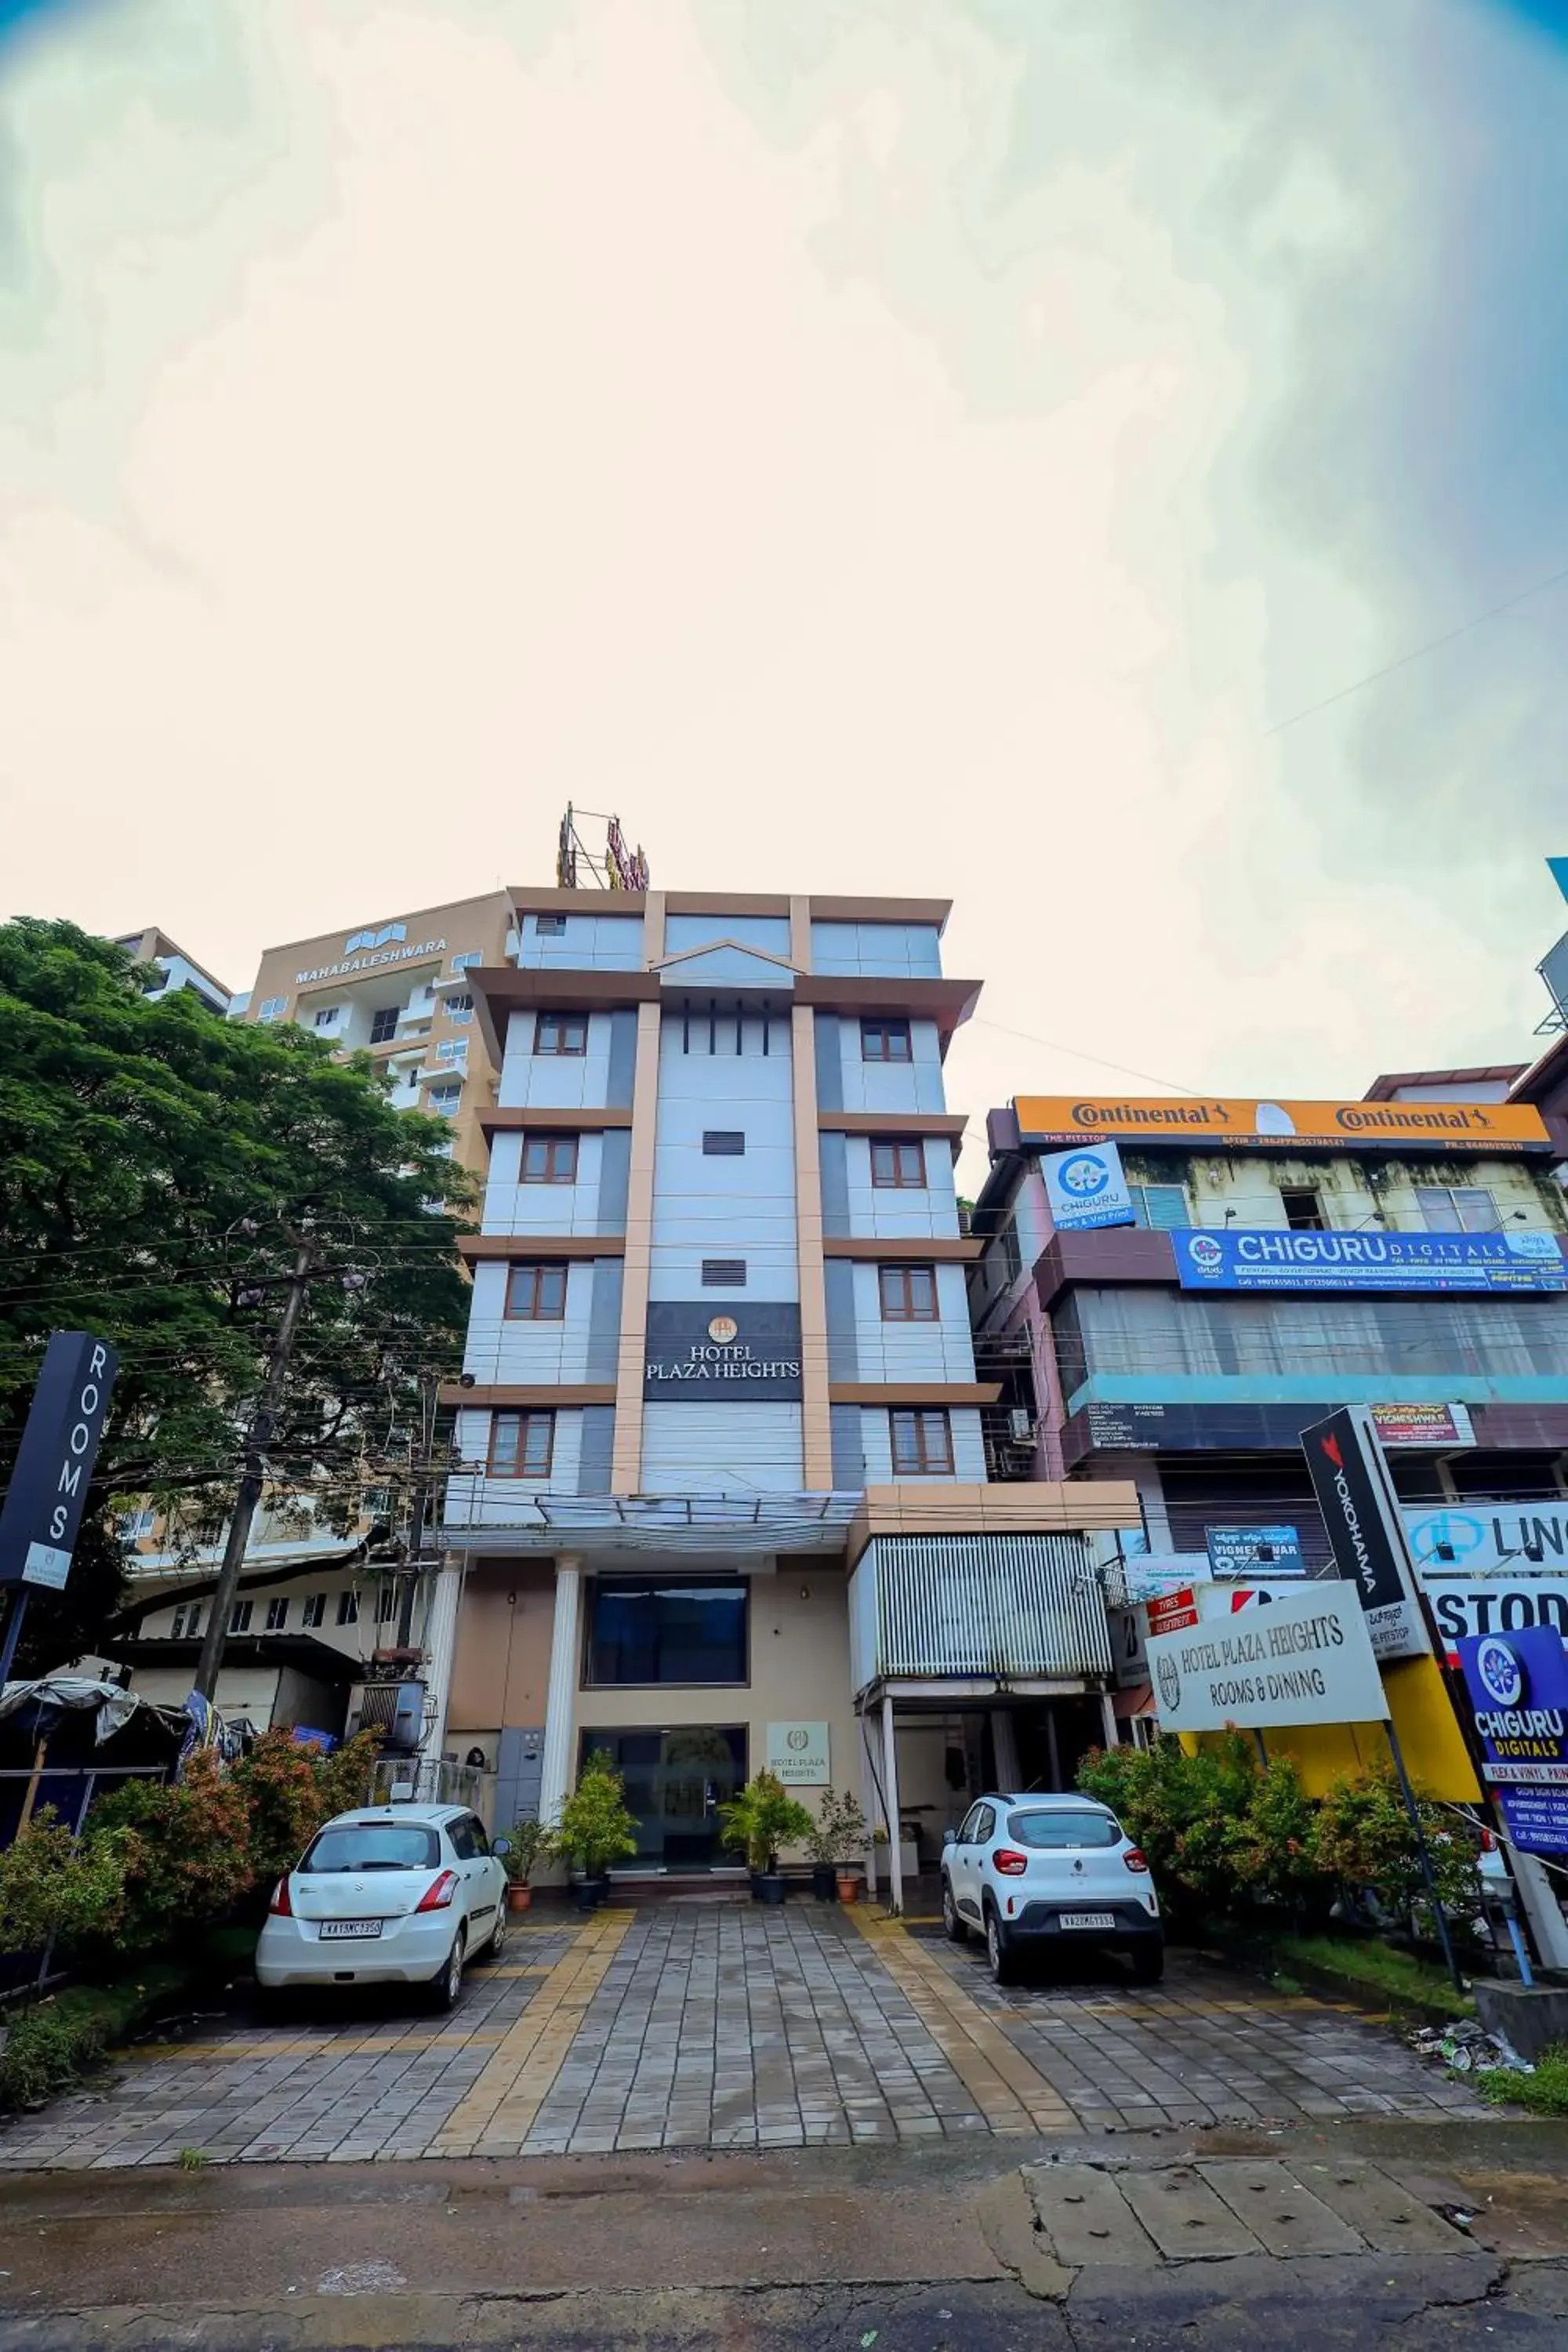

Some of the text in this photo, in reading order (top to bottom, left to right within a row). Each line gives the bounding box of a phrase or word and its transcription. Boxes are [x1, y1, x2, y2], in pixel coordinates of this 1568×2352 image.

[296, 938, 448, 984] MAHABALESHWARA
[1072, 1102, 1210, 1127] Continental
[1336, 1107, 1470, 1131] Continental
[1062, 1192, 1120, 1212] CHIGURU
[1238, 1236, 1387, 1261] CHIGURU
[1390, 1243, 1505, 1256] DIGITALS
[691, 1345, 756, 1361] HOTEL
[647, 1362, 800, 1380] PLAZA HEIGHTS
[49, 1344, 107, 1540] ROOMS
[1334, 1468, 1377, 1594] YOKOHAMA
[1492, 1517, 1568, 1556] LIN
[1181, 1614, 1345, 1674] HOTEL PLAZA HEIGHTS
[1210, 1668, 1327, 1707] ROOMS & DINING
[1475, 1708, 1564, 1738] CHIGURU
[1495, 1740, 1559, 1756] DIGITALS
